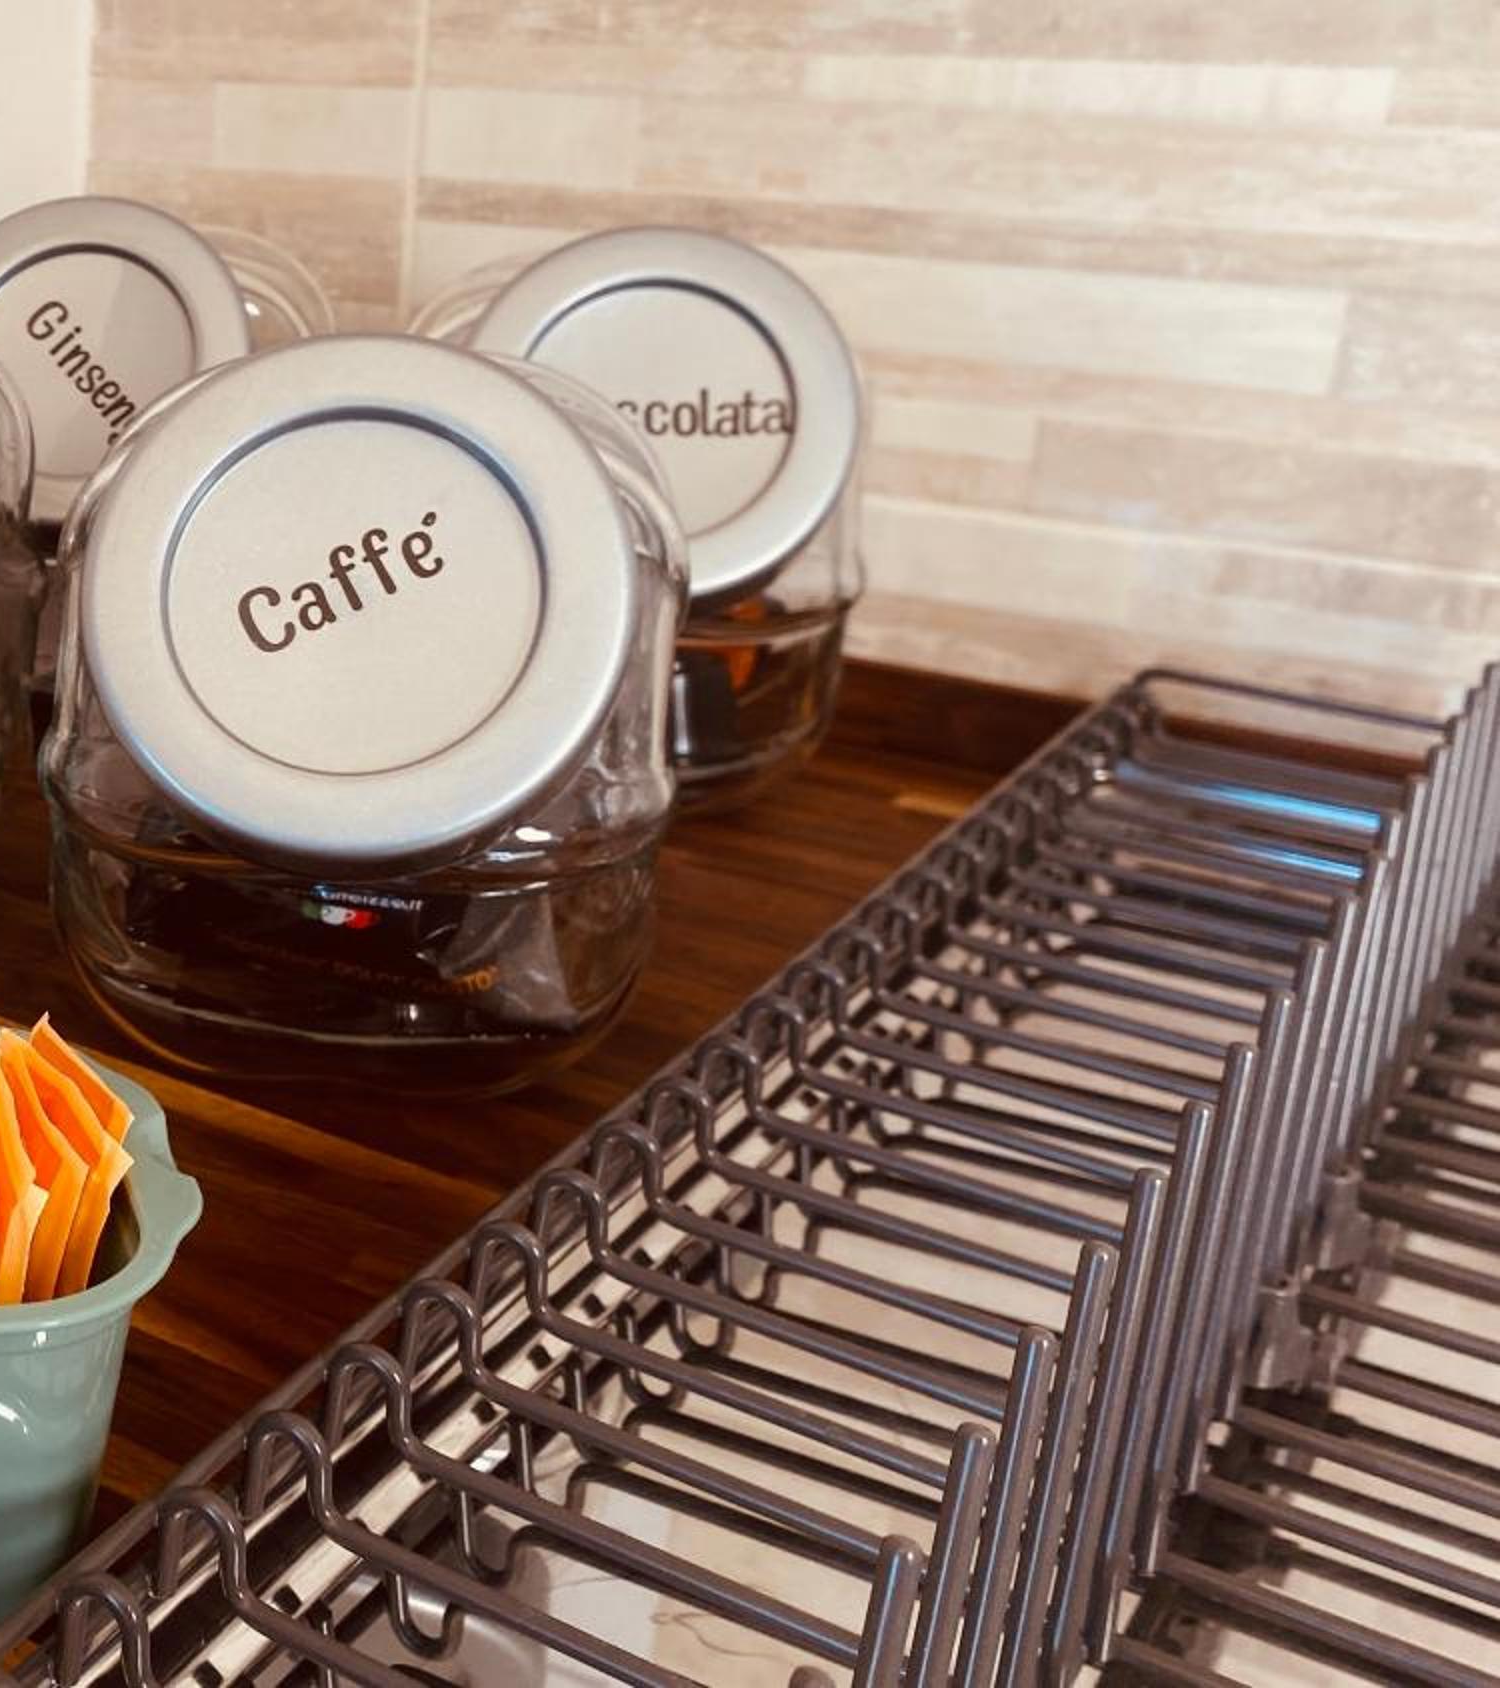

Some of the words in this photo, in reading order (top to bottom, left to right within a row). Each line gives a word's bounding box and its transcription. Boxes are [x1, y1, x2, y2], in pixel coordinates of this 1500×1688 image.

[27, 301, 136, 446] Ginsen
[616, 388, 796, 437] colata
[237, 511, 445, 653] Caffé
